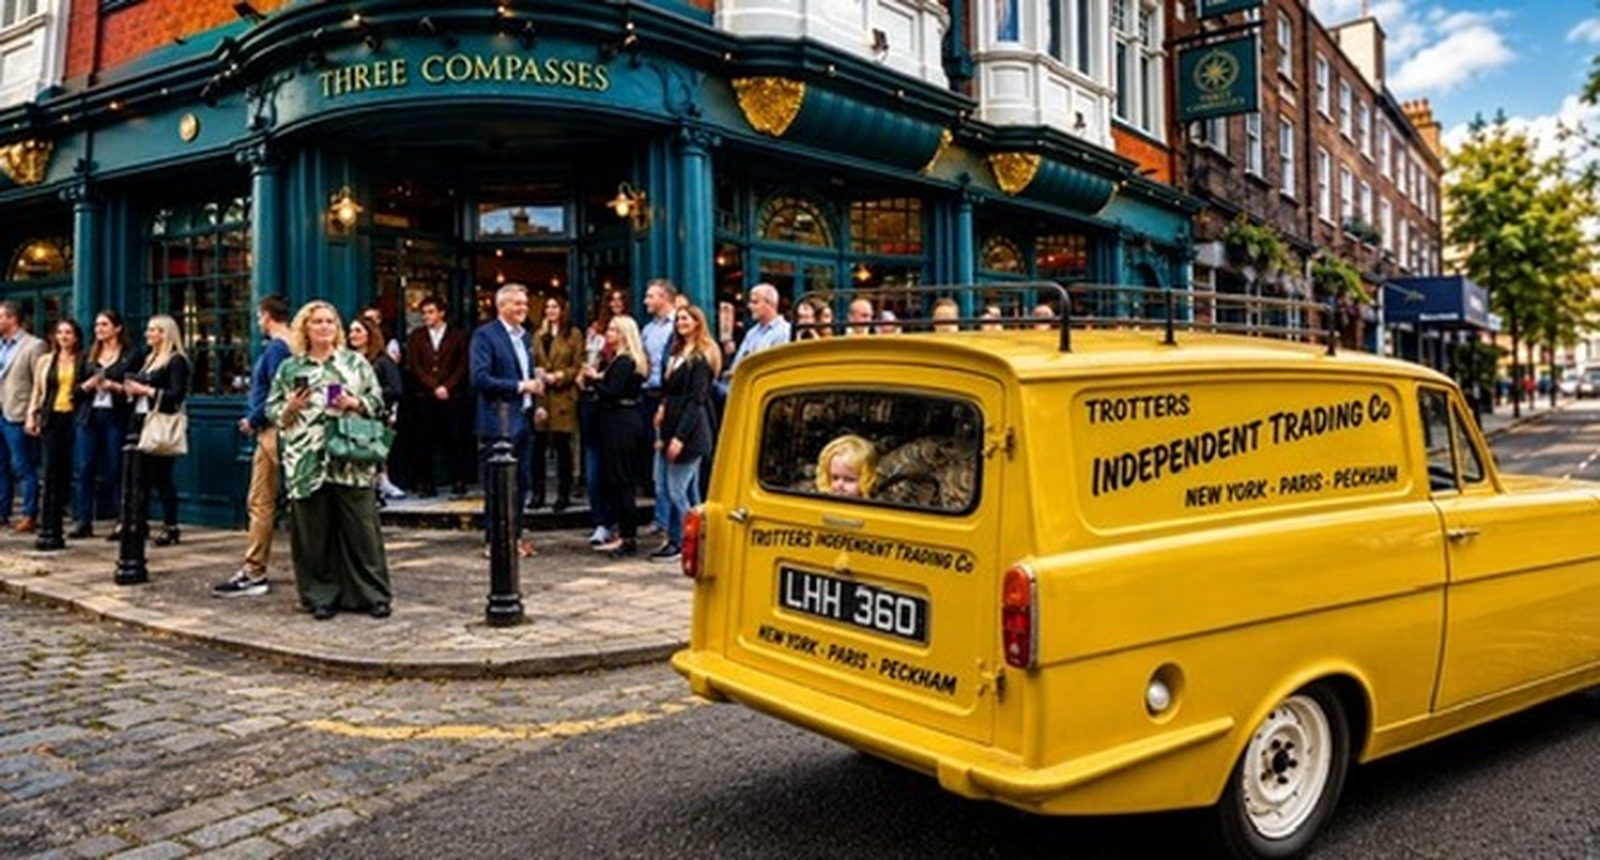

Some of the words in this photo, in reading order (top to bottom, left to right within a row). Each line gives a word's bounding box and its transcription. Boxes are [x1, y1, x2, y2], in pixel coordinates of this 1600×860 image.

[319, 58, 407, 97] THREE
[421, 54, 609, 91] COMPASSES
[1085, 394, 1191, 424] TROTTERS
[1092, 420, 1262, 497] INDEPENDENT
[1269, 400, 1363, 444] TRADING
[1367, 394, 1391, 423] Co
[1184, 485, 1222, 508] NEW
[1226, 479, 1267, 502] YORK
[1279, 472, 1323, 495] PARIS
[1333, 465, 1398, 490] PECKHAM
[751, 529, 813, 547] TROTTERS
[895, 544, 953, 570] TRADING
[955, 553, 974, 574] Co
[786, 571, 841, 618] LHH
[854, 586, 916, 635] 360
[758, 625, 786, 645] NEW
[787, 631, 819, 655] YORK
[827, 644, 869, 670] PARIS
[879, 658, 957, 695] PECKHAM
